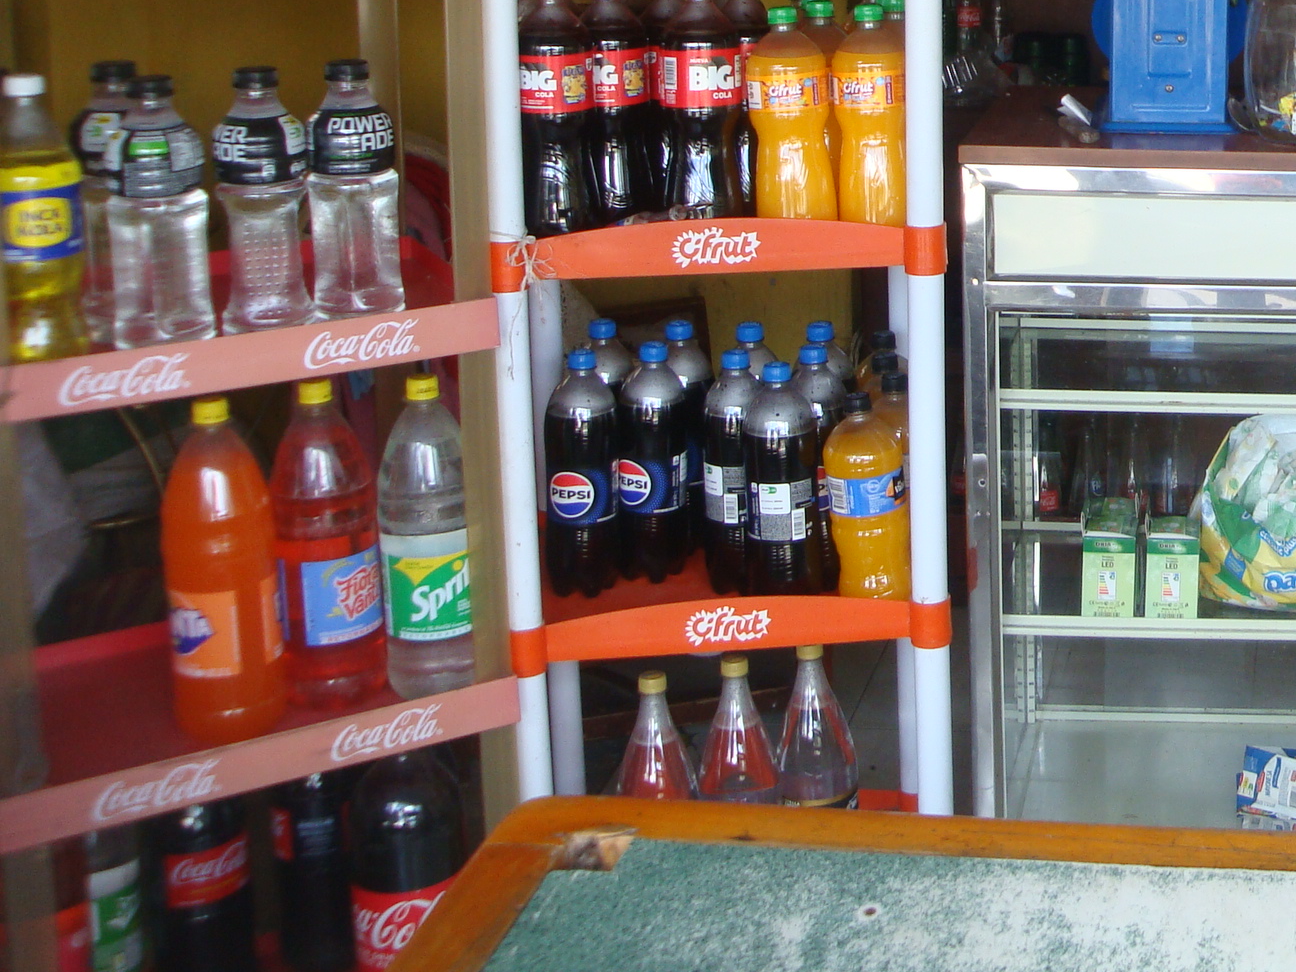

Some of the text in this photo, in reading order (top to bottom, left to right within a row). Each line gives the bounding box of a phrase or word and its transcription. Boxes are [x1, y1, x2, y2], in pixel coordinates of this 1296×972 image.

[593, 65, 618, 85] IG
[689, 65, 735, 91] BIG
[713, 91, 733, 100] COLA
[327, 112, 393, 135] POWER
[361, 129, 394, 152] ADE
[304, 318, 419, 369] Coca-Cola
[59, 352, 191, 406] Coca-Cola
[551, 488, 592, 501] PEPSI
[330, 704, 442, 762] Coca-Cola
